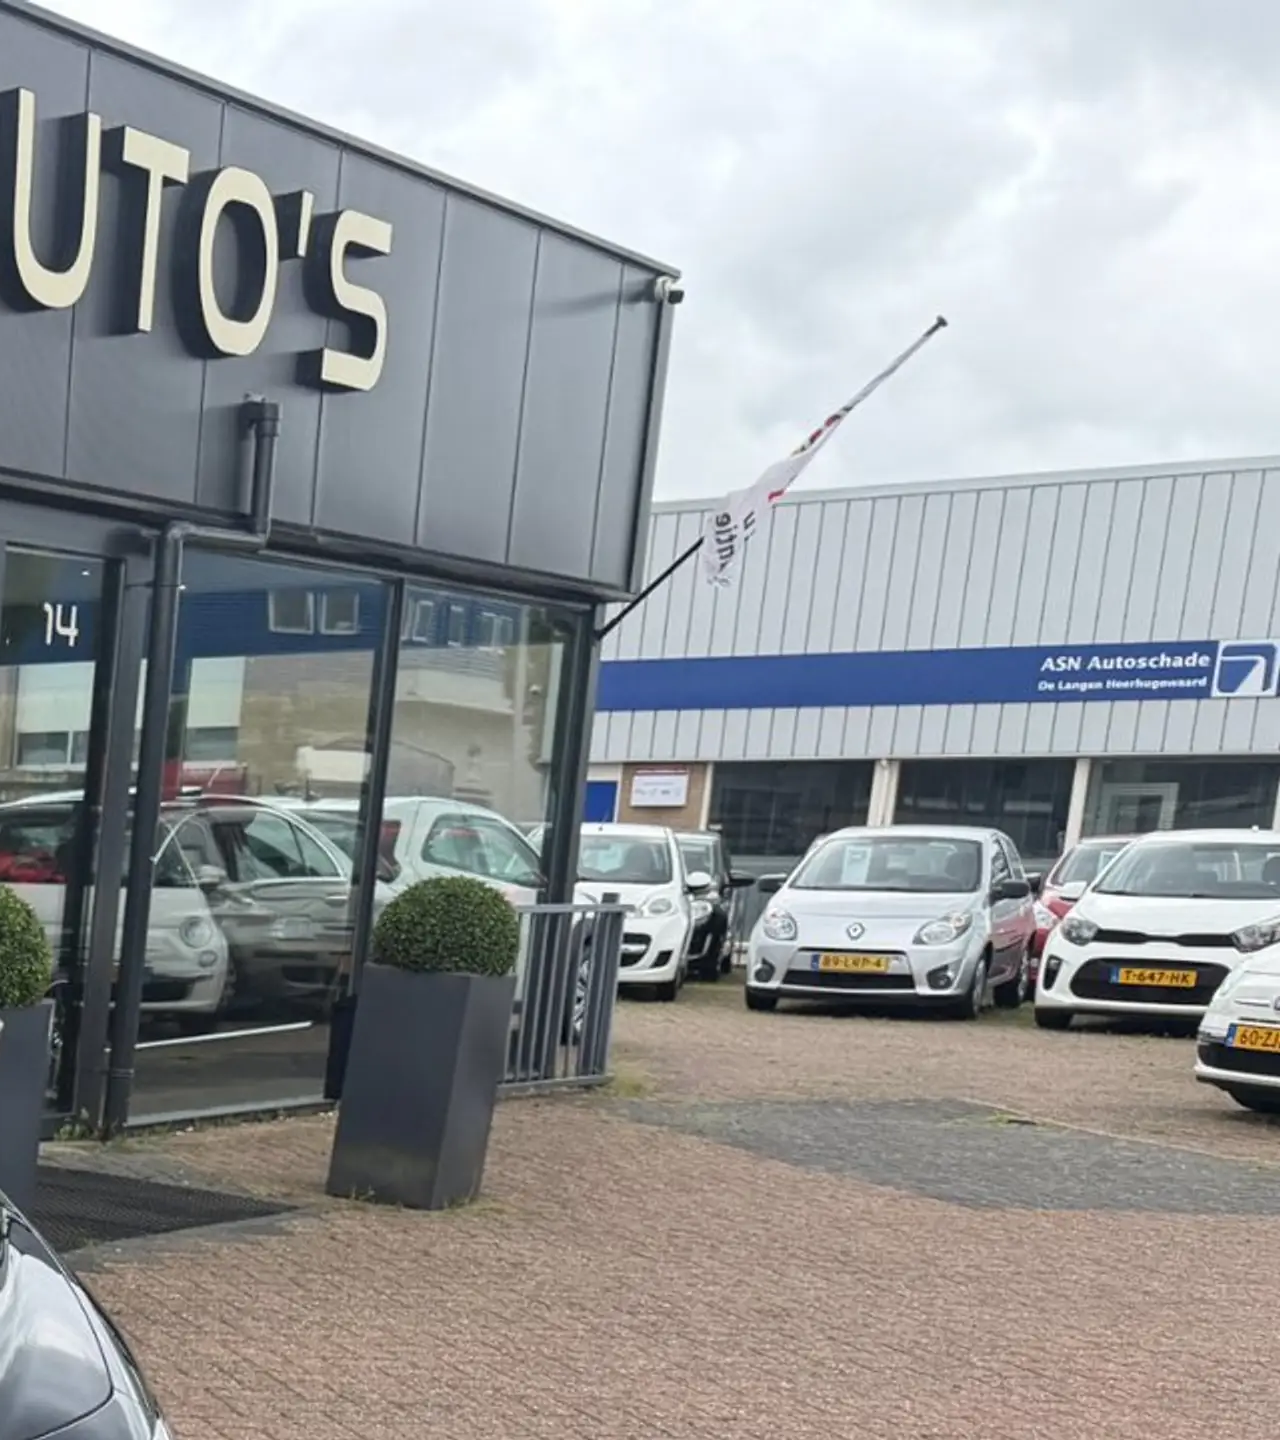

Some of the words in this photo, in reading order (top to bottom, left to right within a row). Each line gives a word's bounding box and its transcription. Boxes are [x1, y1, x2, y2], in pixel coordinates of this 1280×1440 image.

[43, 601, 80, 647] 14
[1040, 656, 1082, 672] ASN
[1087, 652, 1211, 670] Autoschade
[1038, 681, 1055, 691] De
[1125, 969, 1191, 983] T-647-HK
